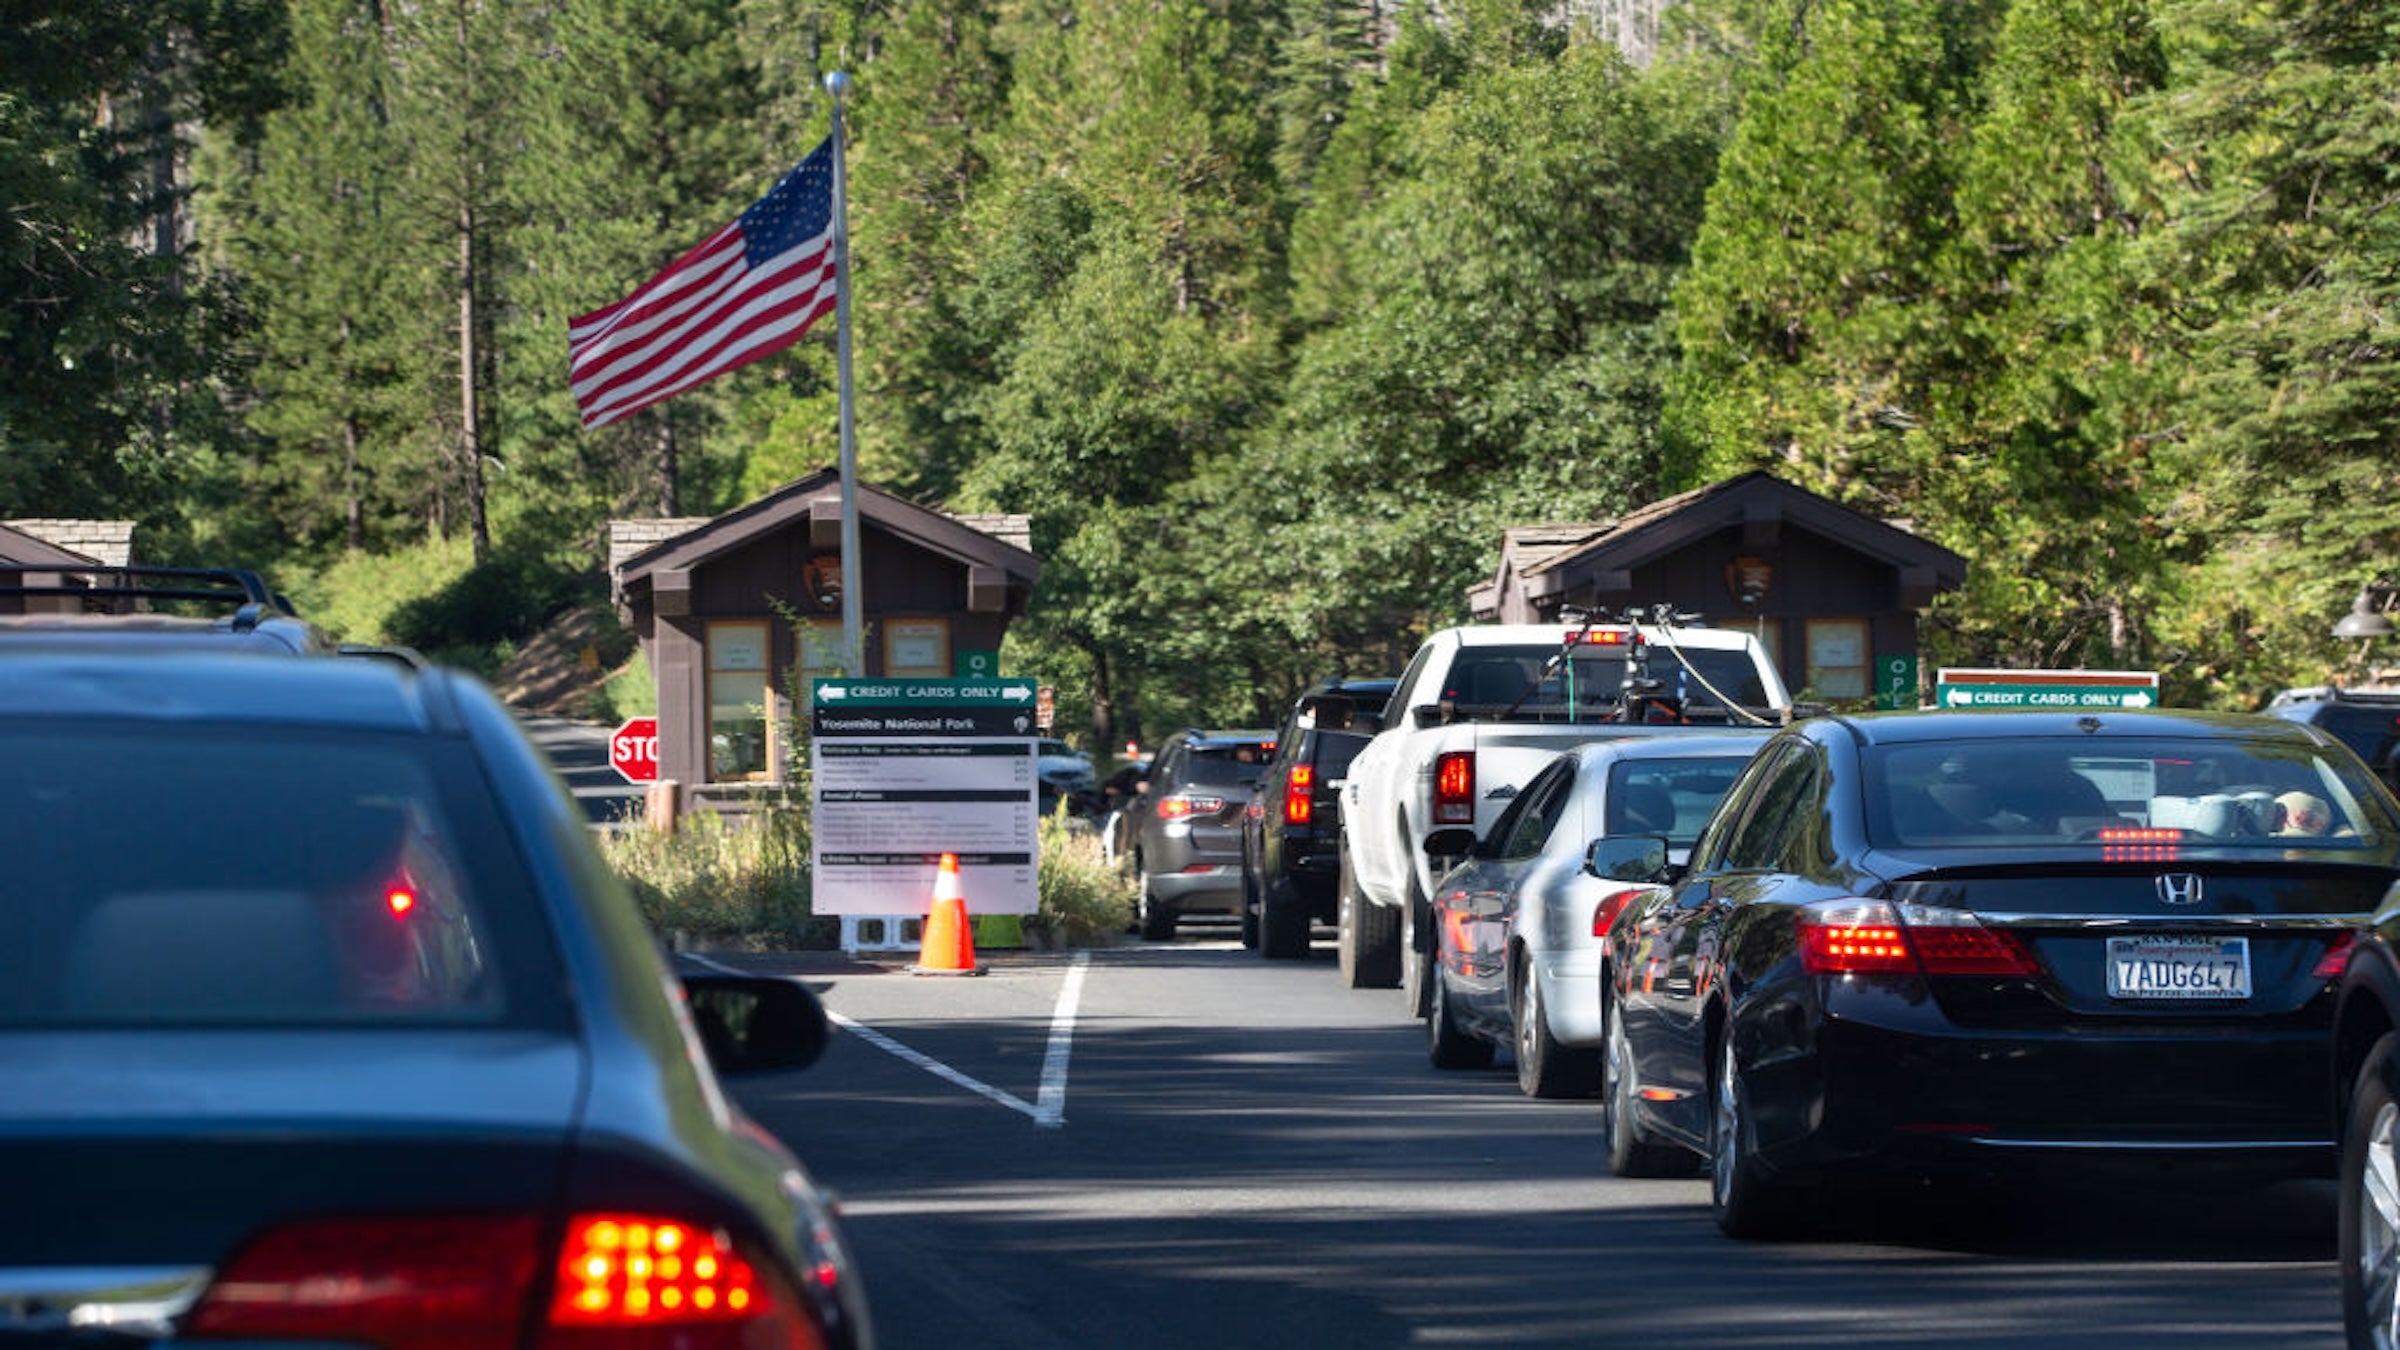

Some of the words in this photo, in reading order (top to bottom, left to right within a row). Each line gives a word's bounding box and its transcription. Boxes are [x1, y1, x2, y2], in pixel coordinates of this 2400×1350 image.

[850, 686, 900, 699] CREDIT
[906, 686, 956, 699] CARDS
[960, 687, 1000, 699] ONLY
[1974, 692, 2024, 704] CREDIT
[2029, 693, 2076, 705] CARDS
[2081, 694, 2120, 705] ONLY
[819, 717, 881, 731] Yosemite
[885, 718, 942, 731] National
[945, 718, 976, 731] Park
[2117, 960, 2238, 988] 7ADG647
